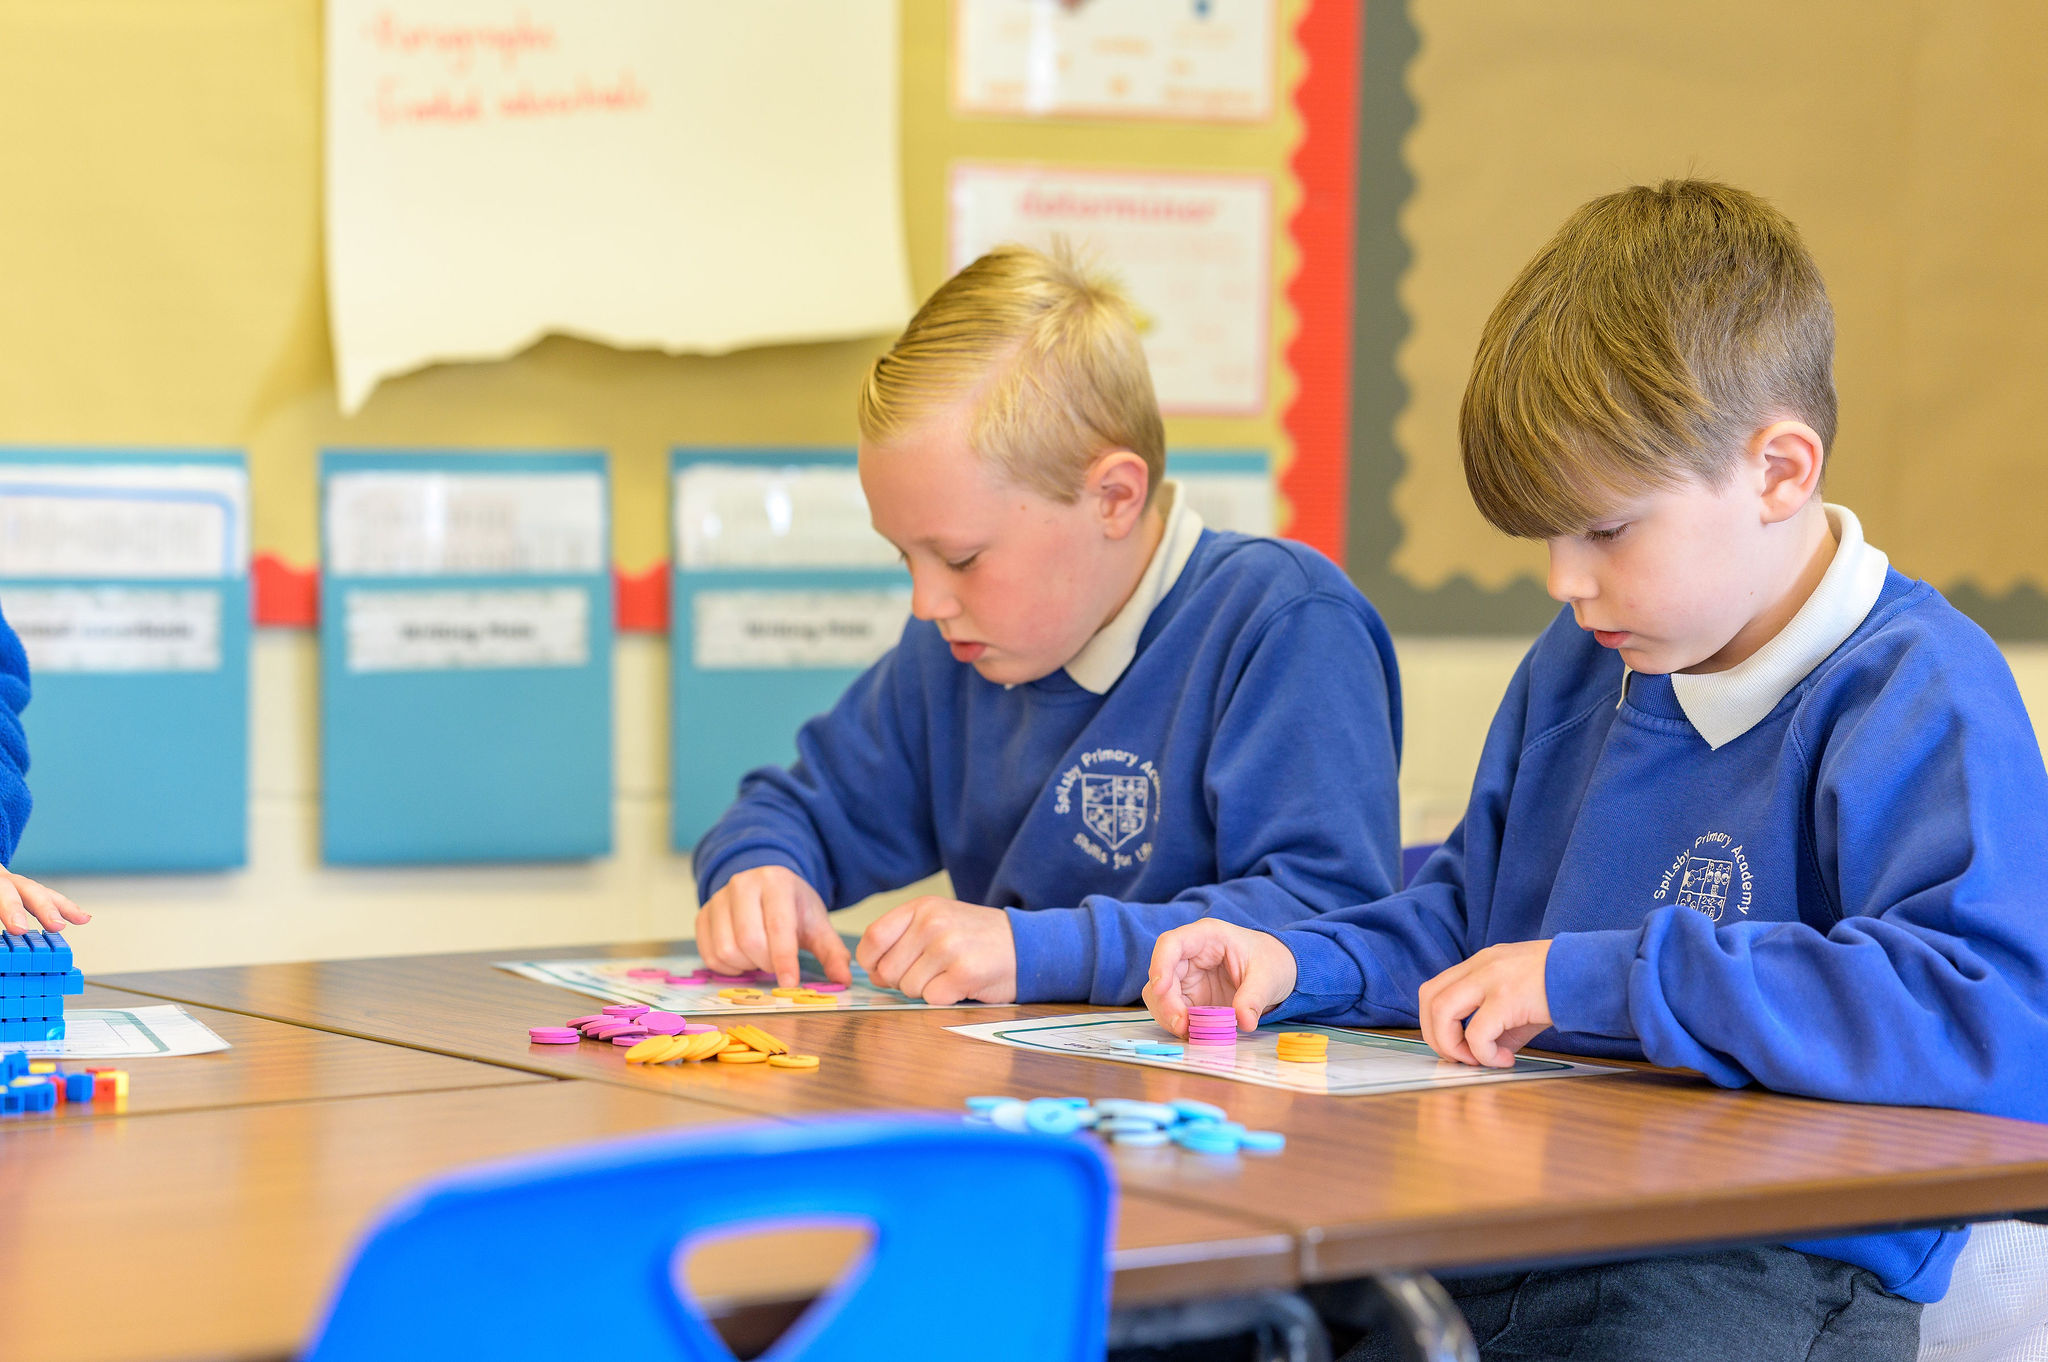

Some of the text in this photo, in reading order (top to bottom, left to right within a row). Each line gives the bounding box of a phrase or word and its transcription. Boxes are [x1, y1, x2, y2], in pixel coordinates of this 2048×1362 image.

[1081, 748, 1139, 767] Primary
[1695, 831, 1733, 848] Primary
[1731, 845, 1754, 915] Academy
